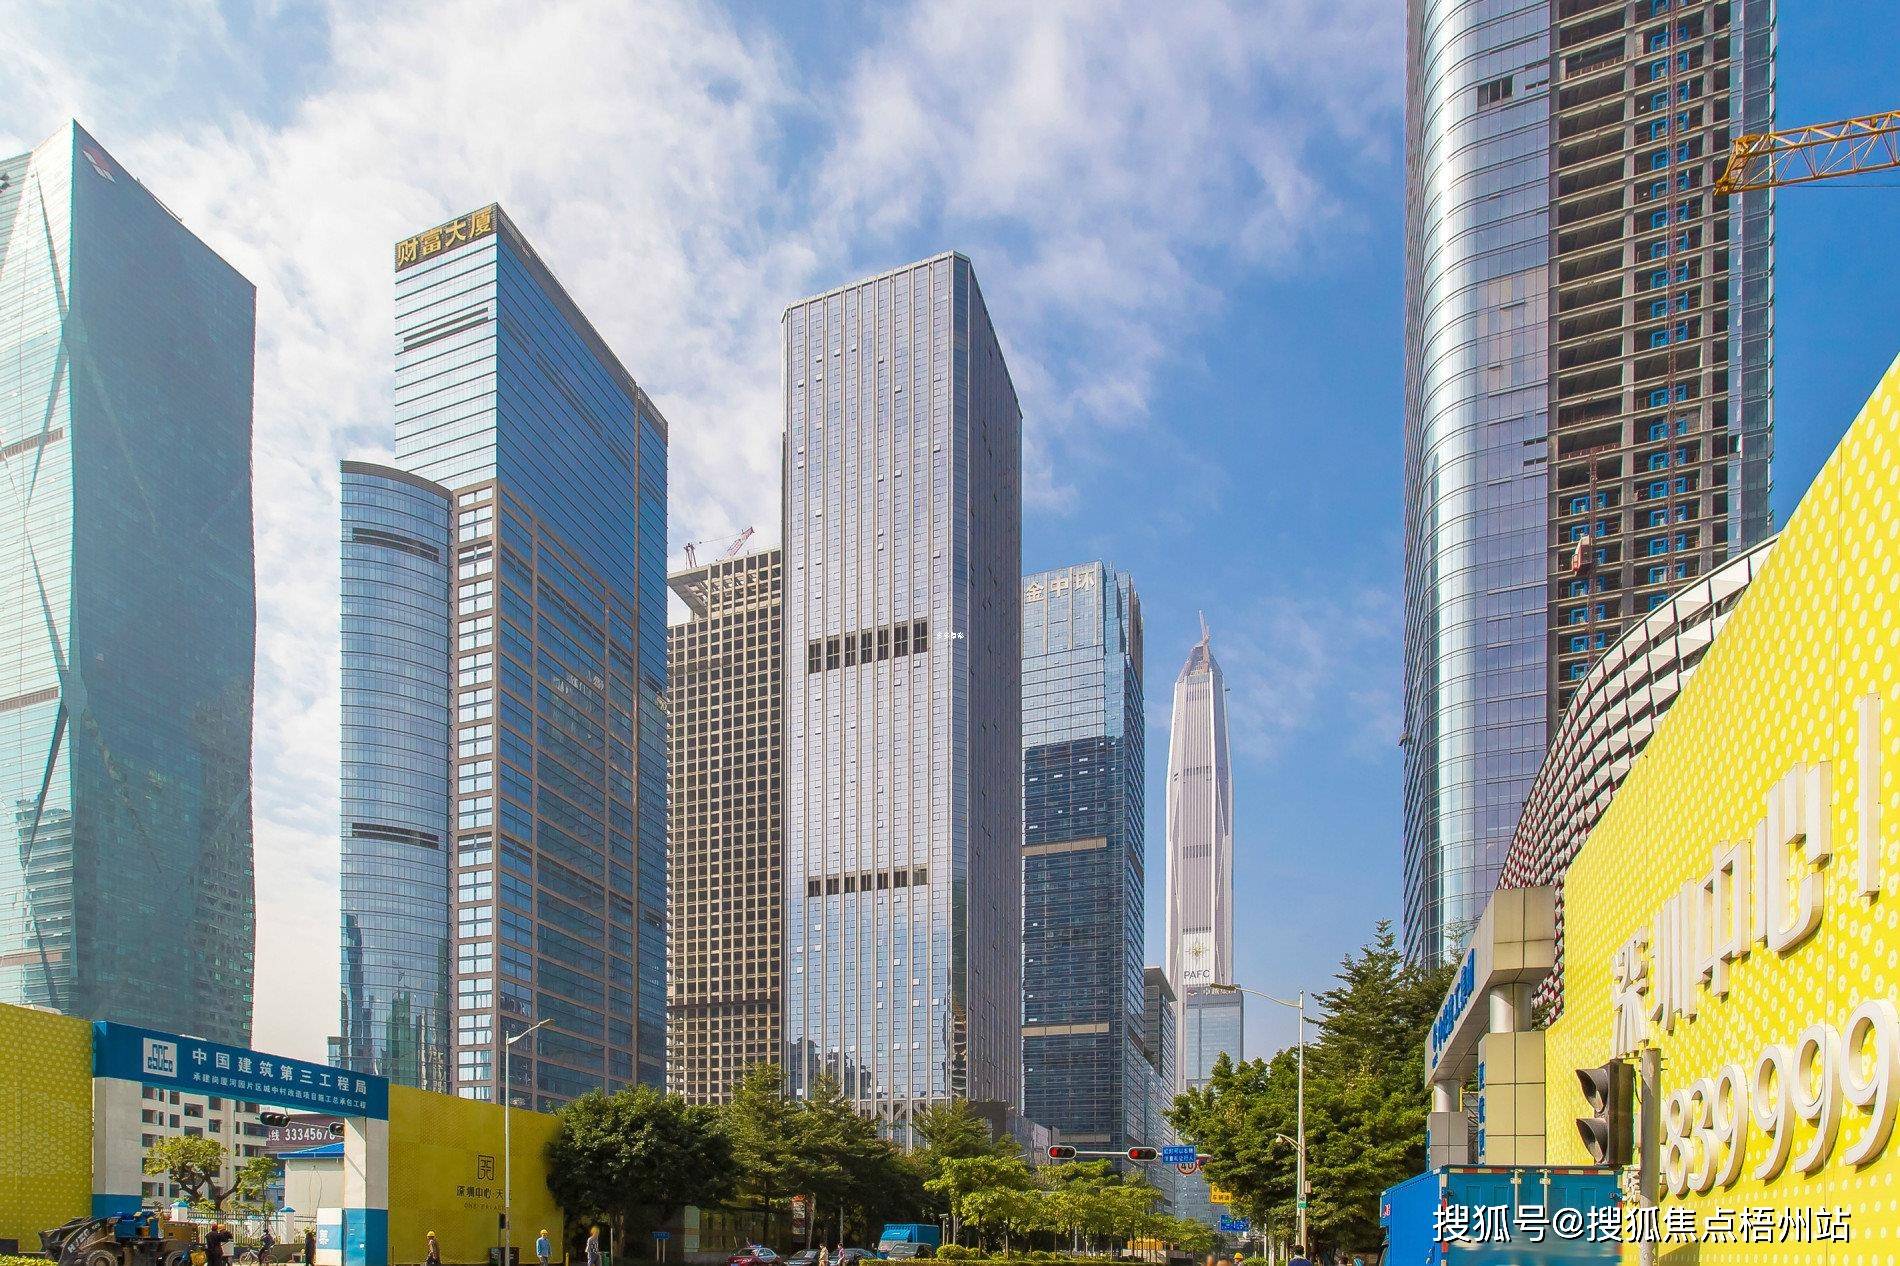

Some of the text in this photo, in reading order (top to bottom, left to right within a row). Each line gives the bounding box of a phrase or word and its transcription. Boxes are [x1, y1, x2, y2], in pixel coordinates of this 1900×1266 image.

[397, 206, 492, 267] 财富大厦
[1024, 571, 1095, 604] 金中环
[1184, 969, 1210, 979] PAFC
[191, 1047, 367, 1096] 中国建筑第三工程局
